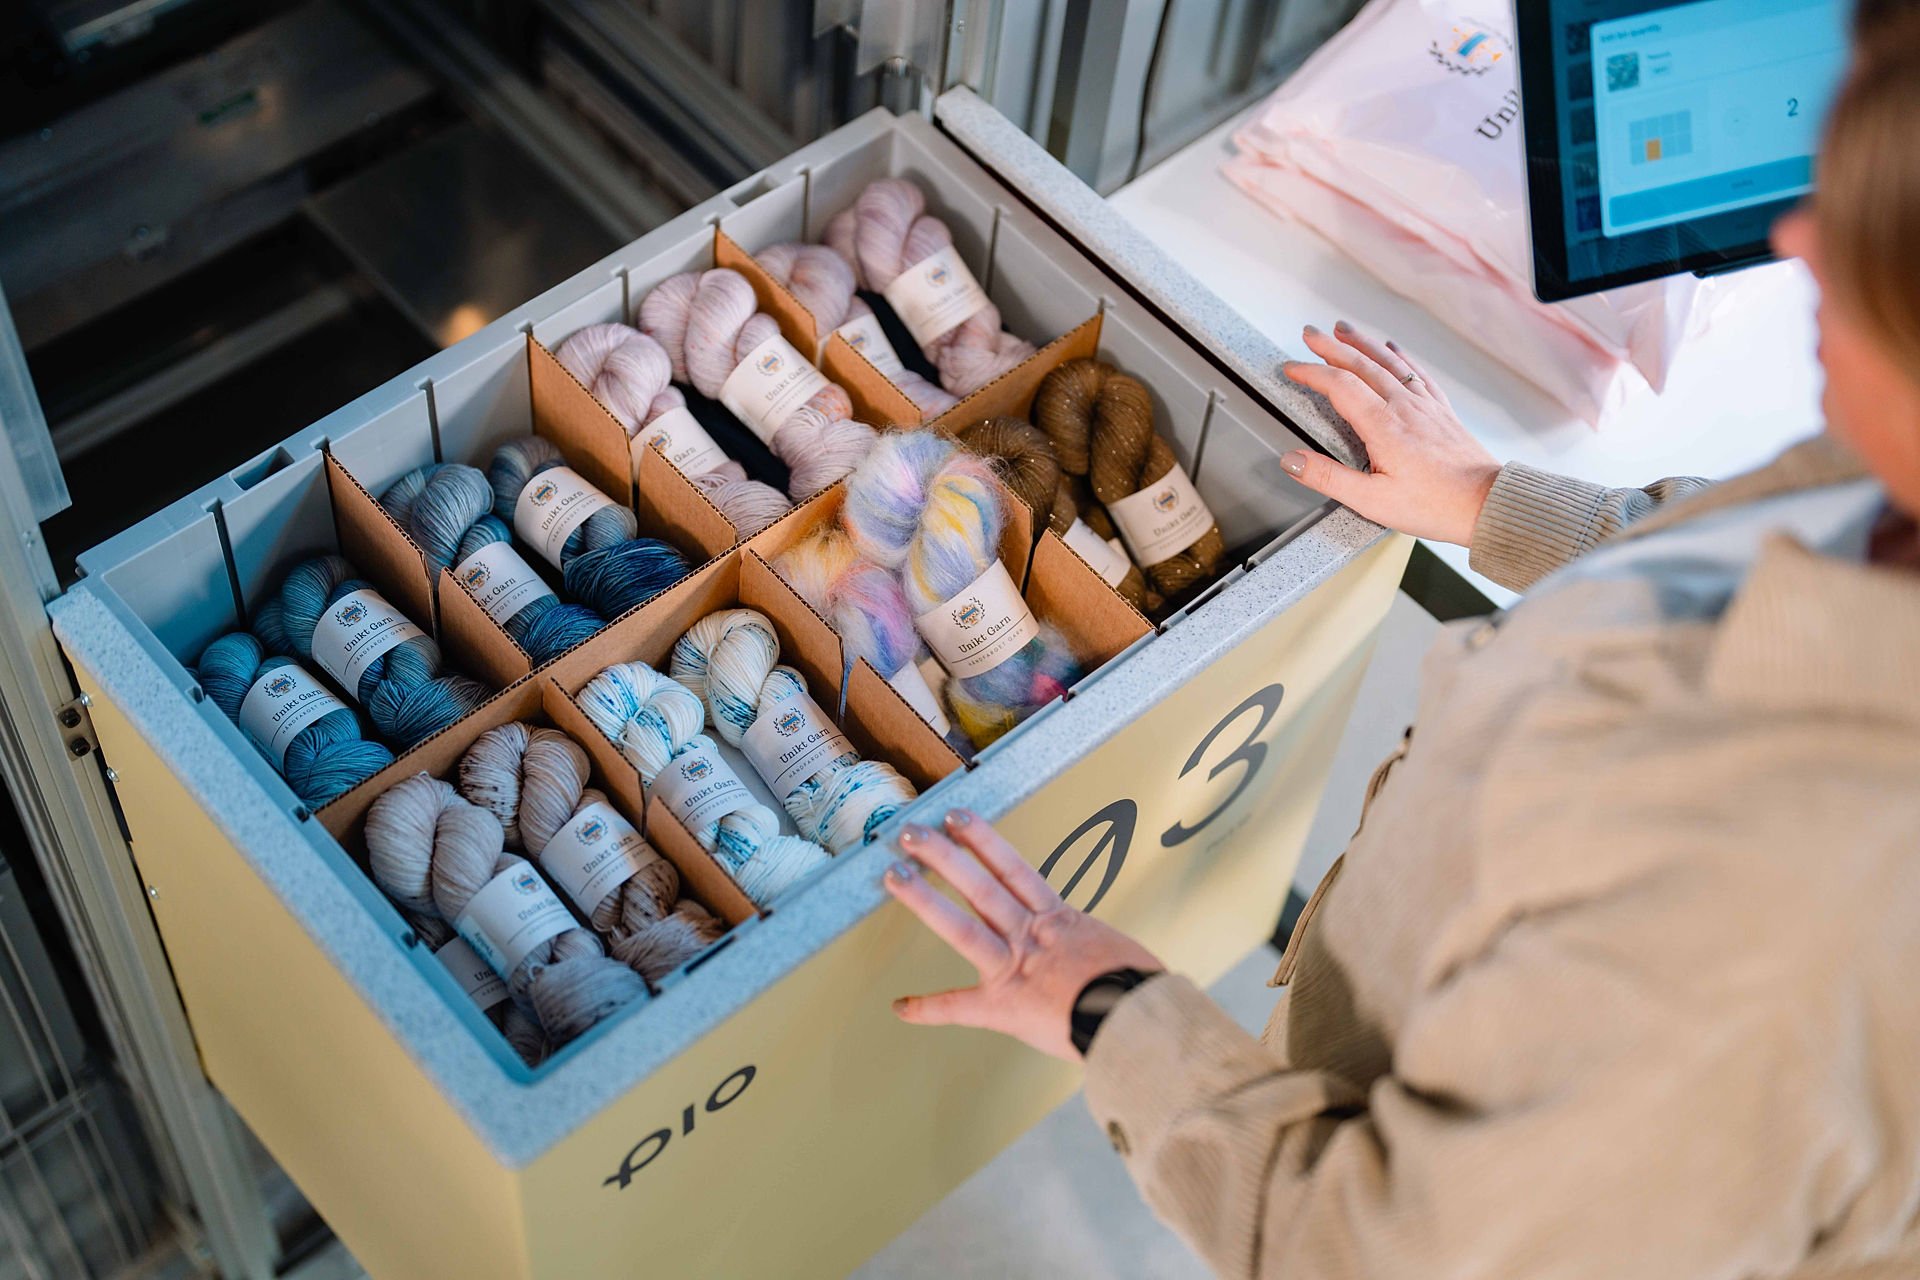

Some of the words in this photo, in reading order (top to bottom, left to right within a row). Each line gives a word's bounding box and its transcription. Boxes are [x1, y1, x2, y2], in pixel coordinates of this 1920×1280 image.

[1475, 89, 1518, 140] Uni
[1787, 98, 1798, 117] 2
[765, 380, 789, 401] Unikt
[674, 446, 697, 463] Garn
[541, 505, 563, 530] Unikt
[561, 490, 584, 506] Garn
[480, 594, 493, 607] ikt
[492, 577, 516, 595] Garn
[344, 629, 370, 652] Unikt
[369, 616, 394, 631] Garn
[958, 632, 988, 653] Unikt
[986, 615, 1012, 636] Garn
[271, 698, 299, 722] Unikt
[298, 688, 323, 702] Garn
[779, 740, 808, 763] Unikt
[807, 728, 831, 744] Garn
[684, 786, 714, 807] Unikt
[713, 779, 737, 790] Garn
[582, 849, 611, 874] Unikt
[610, 836, 633, 852] Garn
